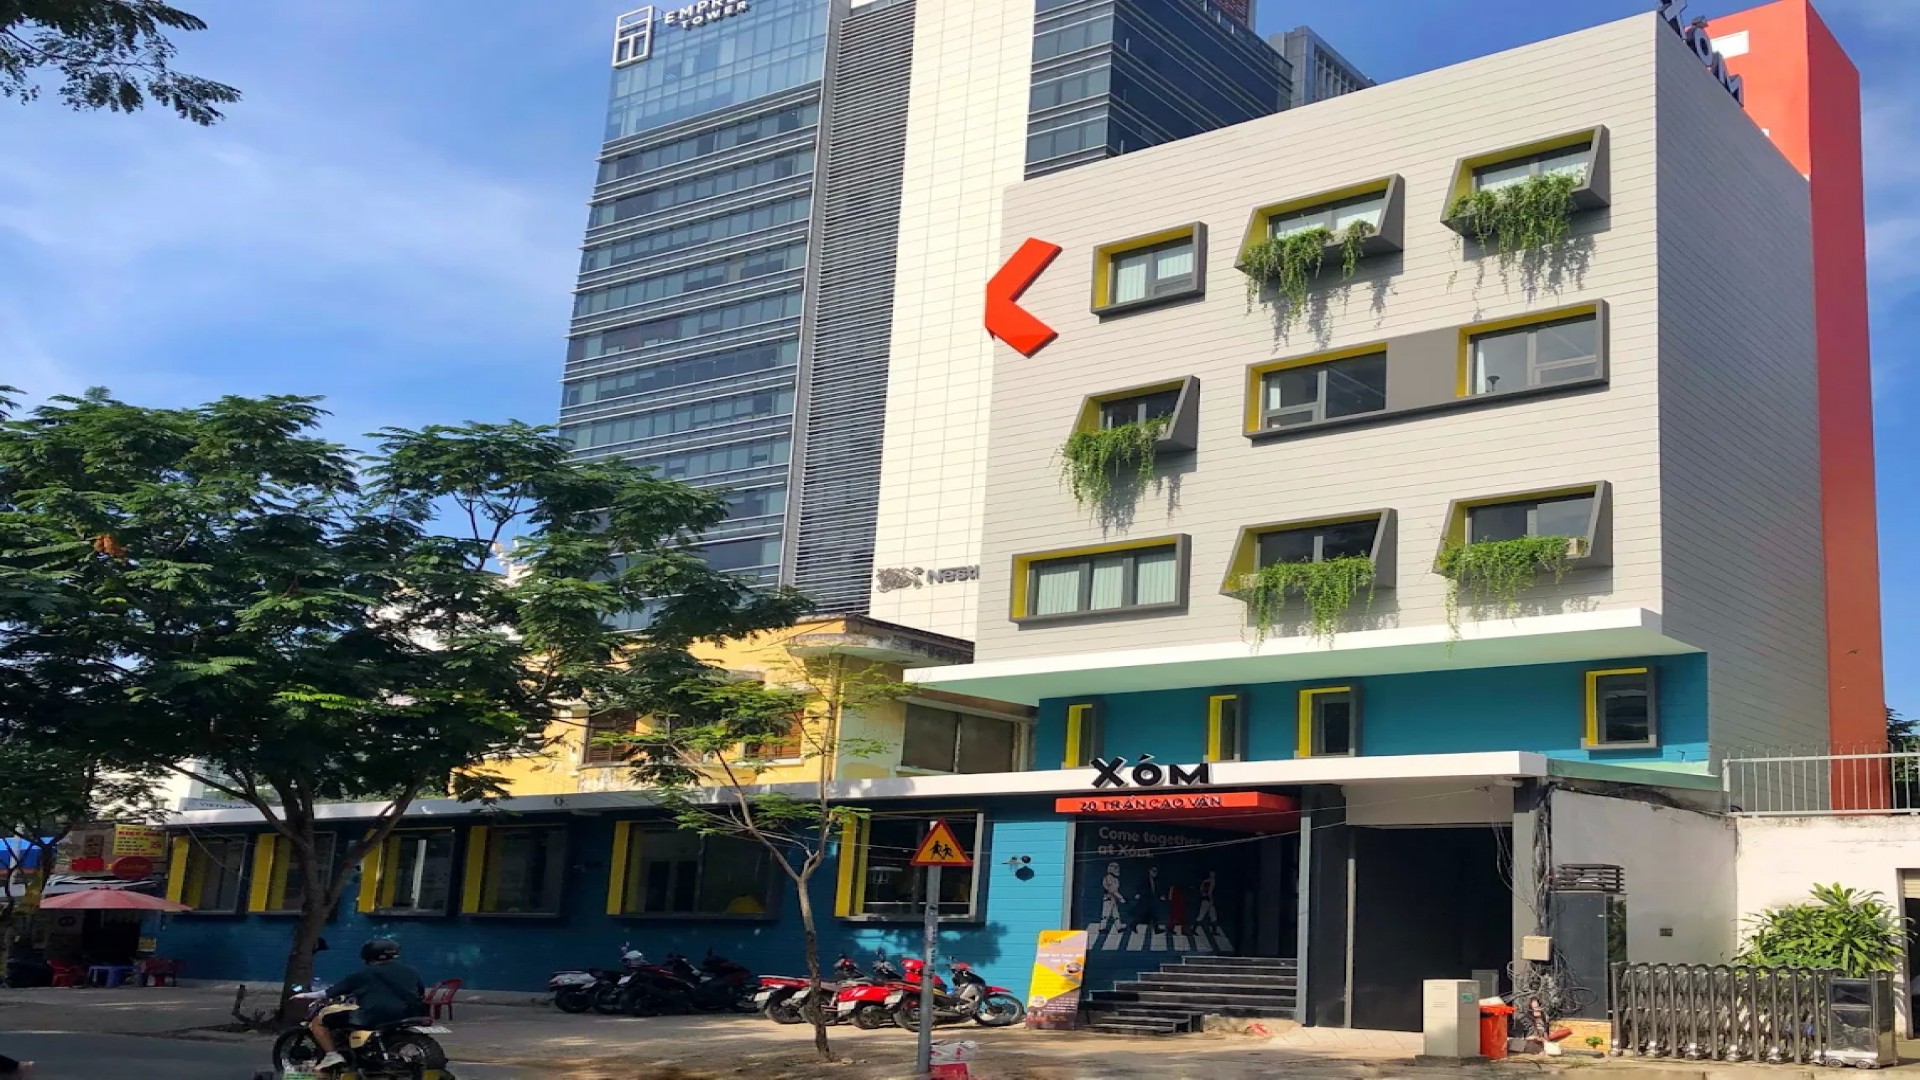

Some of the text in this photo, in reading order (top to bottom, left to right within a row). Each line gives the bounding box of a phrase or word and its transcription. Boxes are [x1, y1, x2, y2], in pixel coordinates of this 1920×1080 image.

[680, 1, 747, 29] TOWER
[1090, 753, 1213, 788] XÓM
[1080, 800, 1097, 811] 20
[1149, 797, 1185, 810] CAO
[1099, 826, 1202, 847] Come together
[1097, 844, 1116, 856] at
